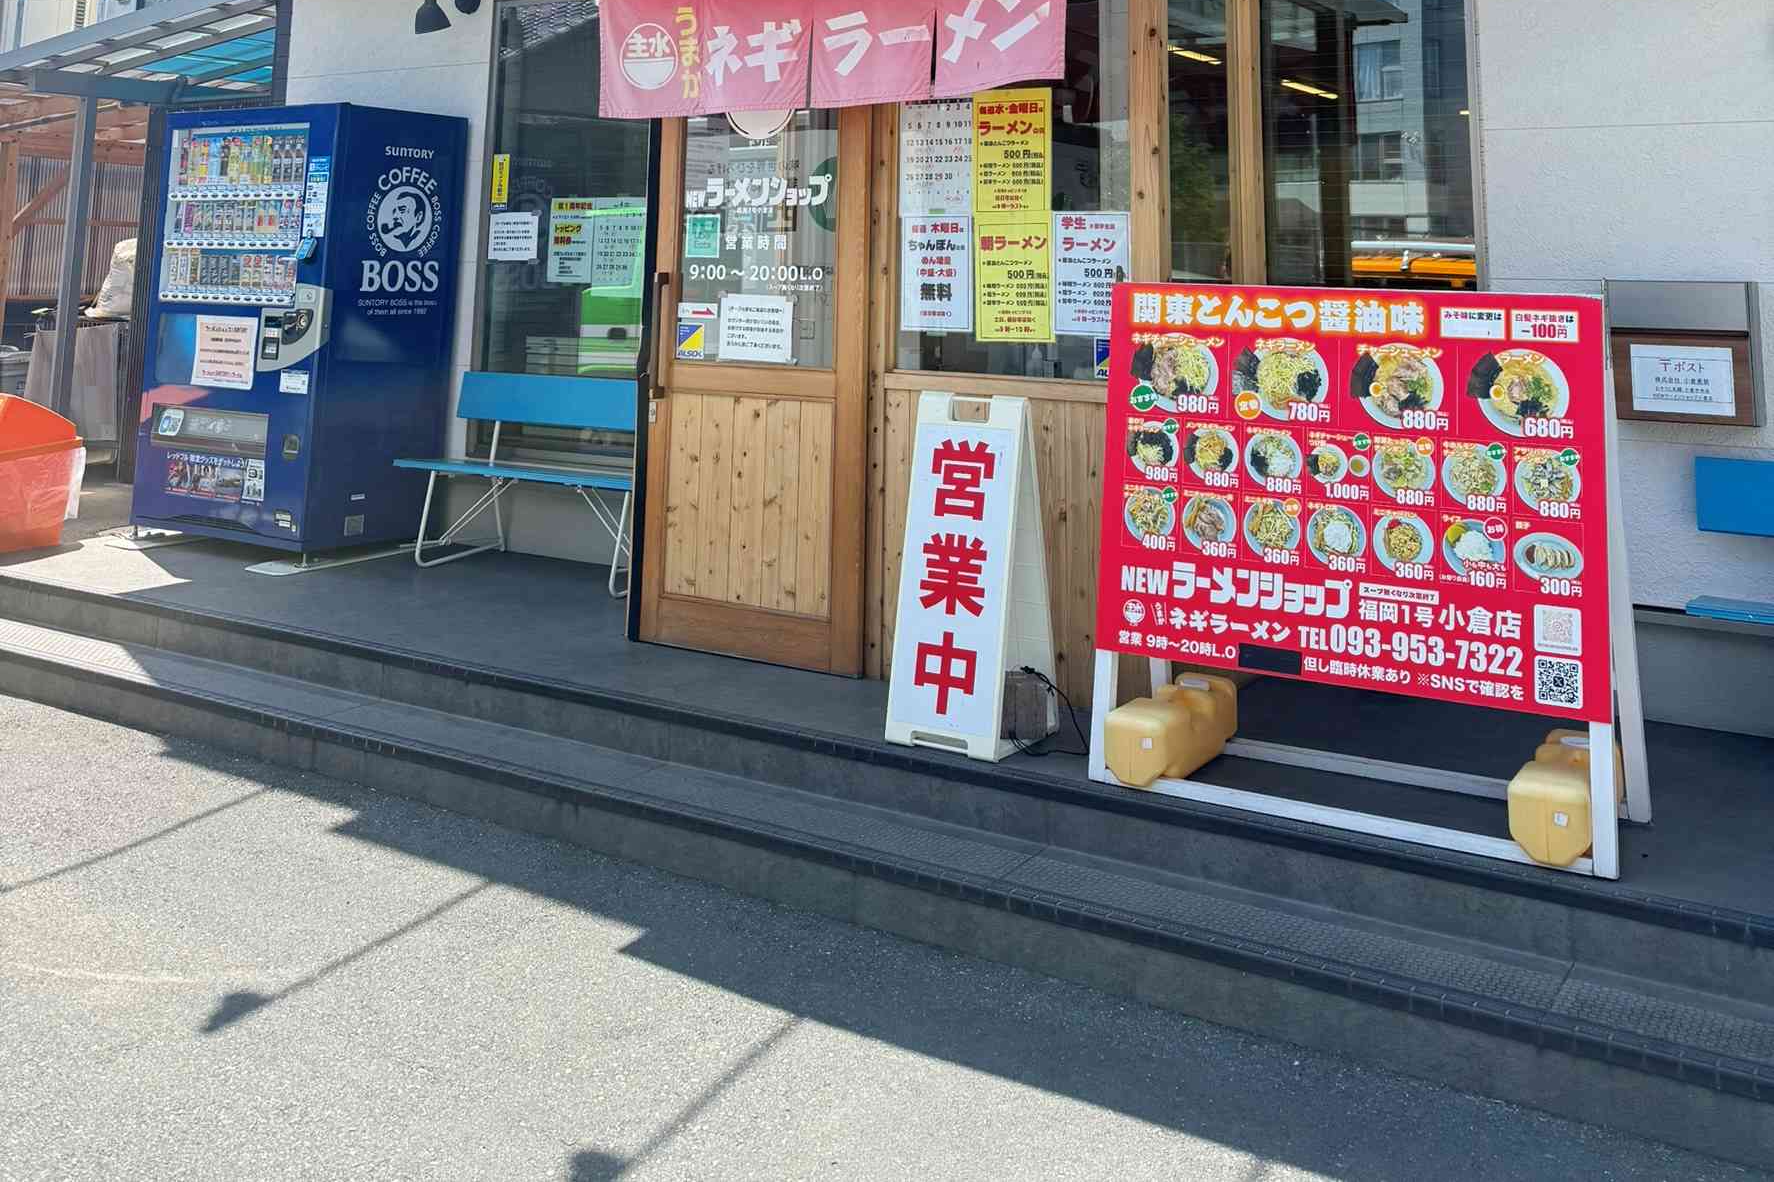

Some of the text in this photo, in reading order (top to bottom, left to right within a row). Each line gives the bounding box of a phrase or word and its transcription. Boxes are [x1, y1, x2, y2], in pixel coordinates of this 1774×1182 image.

[625, 32, 671, 59] 主水
[385, 145, 435, 159] SUNTORY
[378, 166, 438, 195] COFFEE
[705, 173, 833, 207] ラーメンショップ
[366, 192, 387, 257] BOSS COFFEE
[418, 195, 442, 258] BOSS COFFEE
[725, 234, 787, 251] 営業時間
[1062, 237, 1116, 252] ラーメン
[359, 259, 440, 293] BOSS
[689, 264, 727, 280] 9:00
[1132, 292, 1425, 335] 関東とんこつ醤油味
[1254, 338, 1316, 352] ネギラーメン
[1356, 344, 1443, 359] チャーシューメン
[1499, 353, 1546, 364] ラーメン
[1177, 394, 1219, 415] 980円
[1288, 402, 1331, 422] 780円
[1402, 410, 1449, 431] 880円
[1524, 417, 1574, 439] 680円
[1145, 466, 1178, 483] 980円
[1204, 471, 1239, 489] 880円
[1266, 477, 1301, 495] 880円
[1396, 488, 1435, 507] 880円
[1466, 494, 1507, 513] 880円
[1539, 501, 1581, 520] 880円
[1142, 534, 1176, 552] 400円
[1202, 540, 1237, 559] 360円
[1263, 547, 1300, 566] 360円
[1328, 555, 1366, 574] 360円
[913, 438, 997, 716] 営業中
[1396, 562, 1434, 581] 360円
[1469, 570, 1507, 590] 160円
[1120, 561, 1353, 619] NEW ラーメンショップ
[1540, 577, 1583, 598] 300円
[1169, 606, 1291, 643] ネギラーメン
[1303, 655, 1411, 685] 但し臨時休業あり
